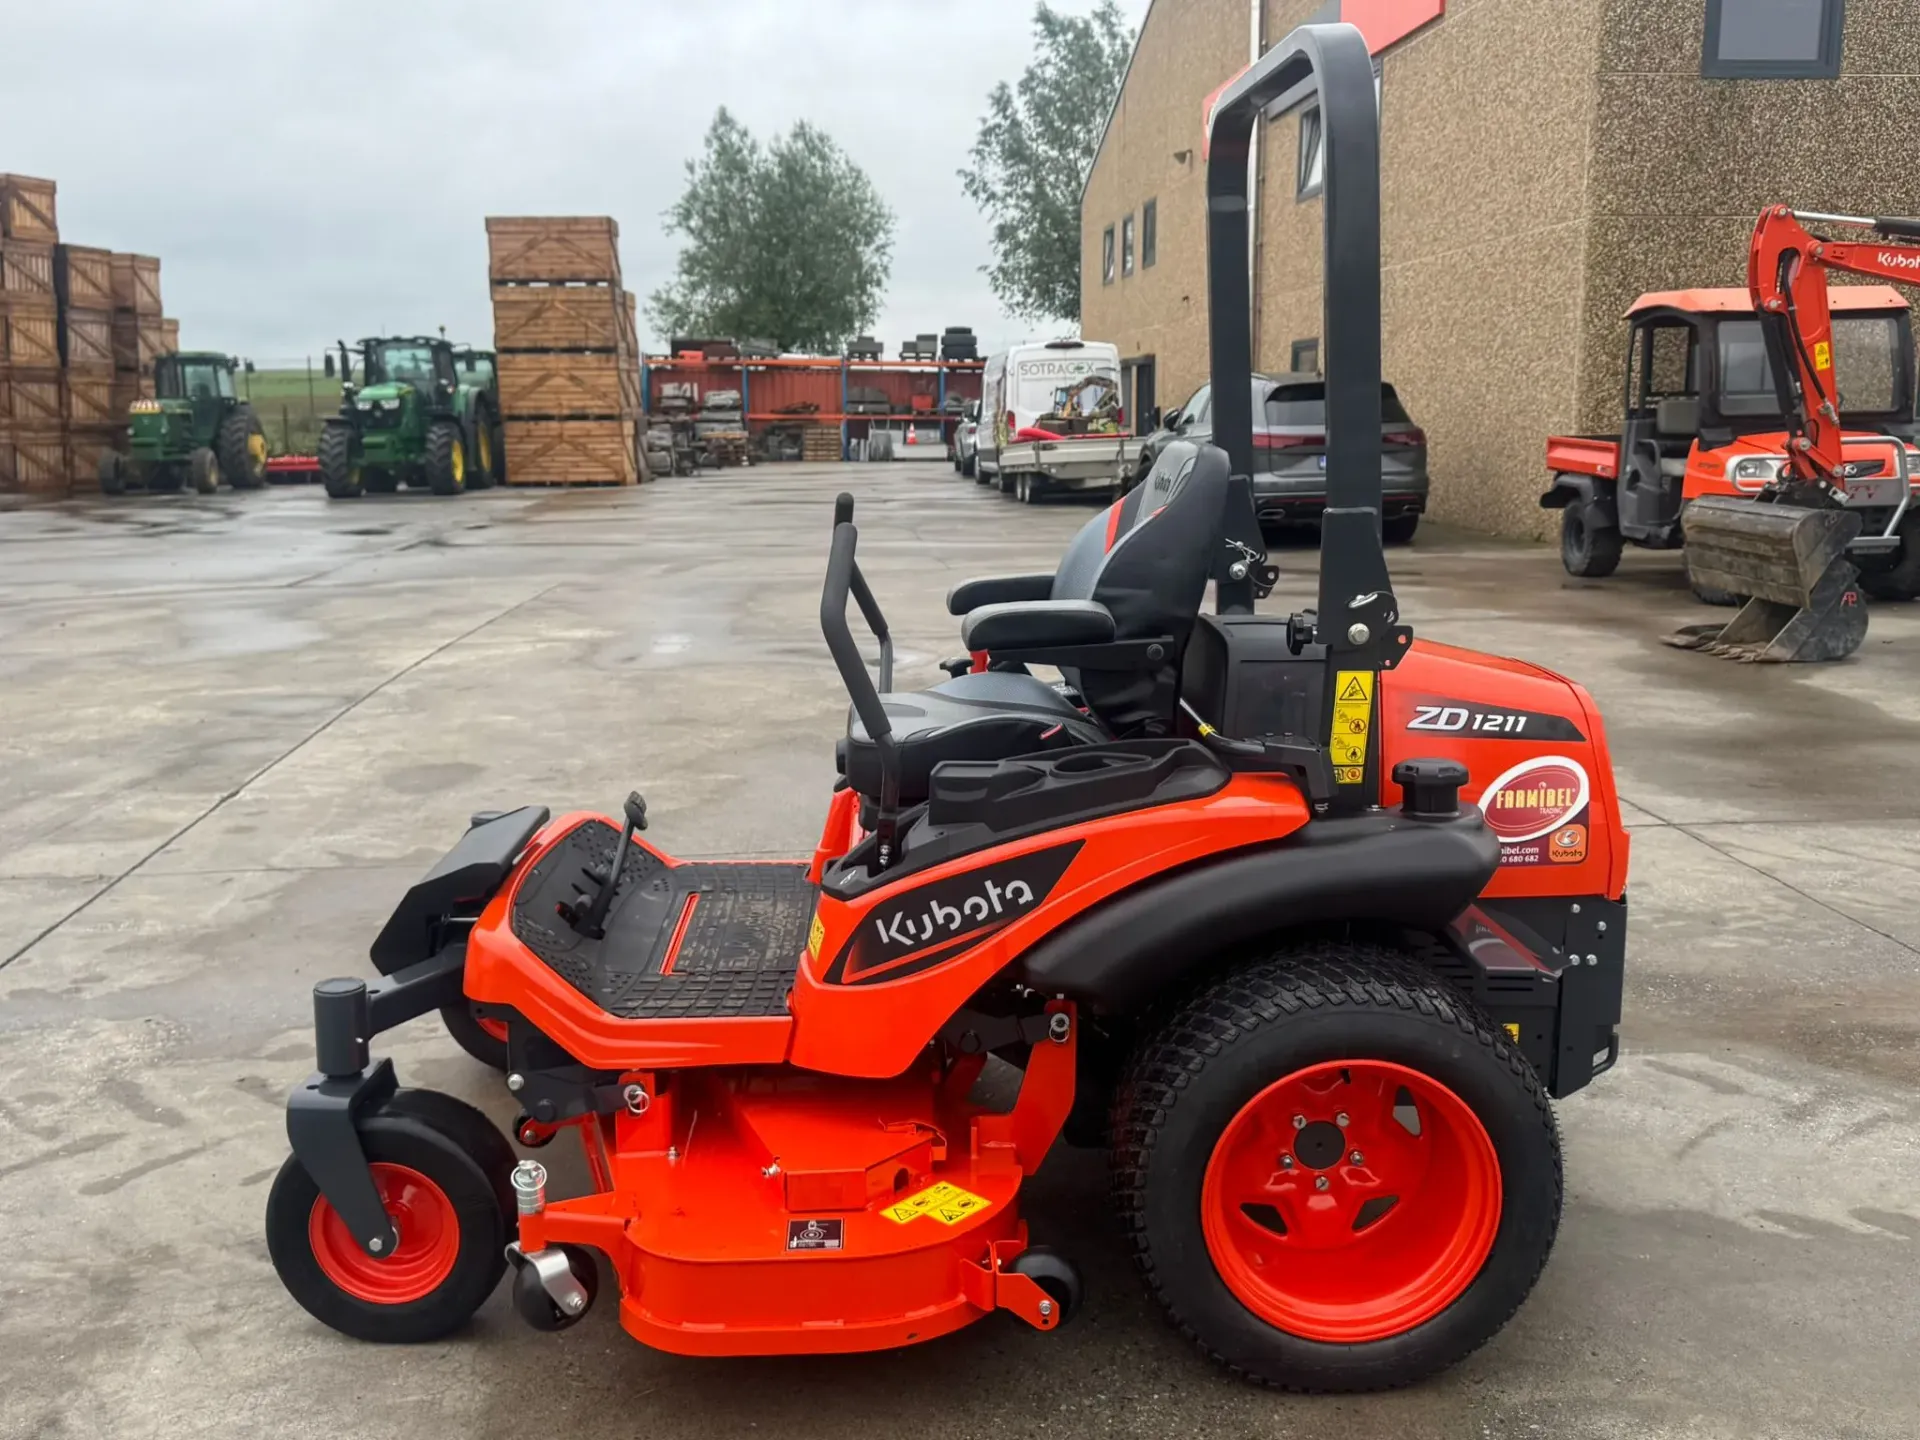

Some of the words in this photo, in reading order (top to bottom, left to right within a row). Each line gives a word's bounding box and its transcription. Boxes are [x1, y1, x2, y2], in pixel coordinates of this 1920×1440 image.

[1406, 705, 1470, 731] ZD
[1472, 713, 1527, 733] 1211
[1496, 786, 1573, 809] FARMIBEL
[1508, 855, 1524, 863] 680
[1525, 854, 1539, 863] 682
[1552, 849, 1583, 858] Kubota
[875, 880, 1034, 946] Kubota
